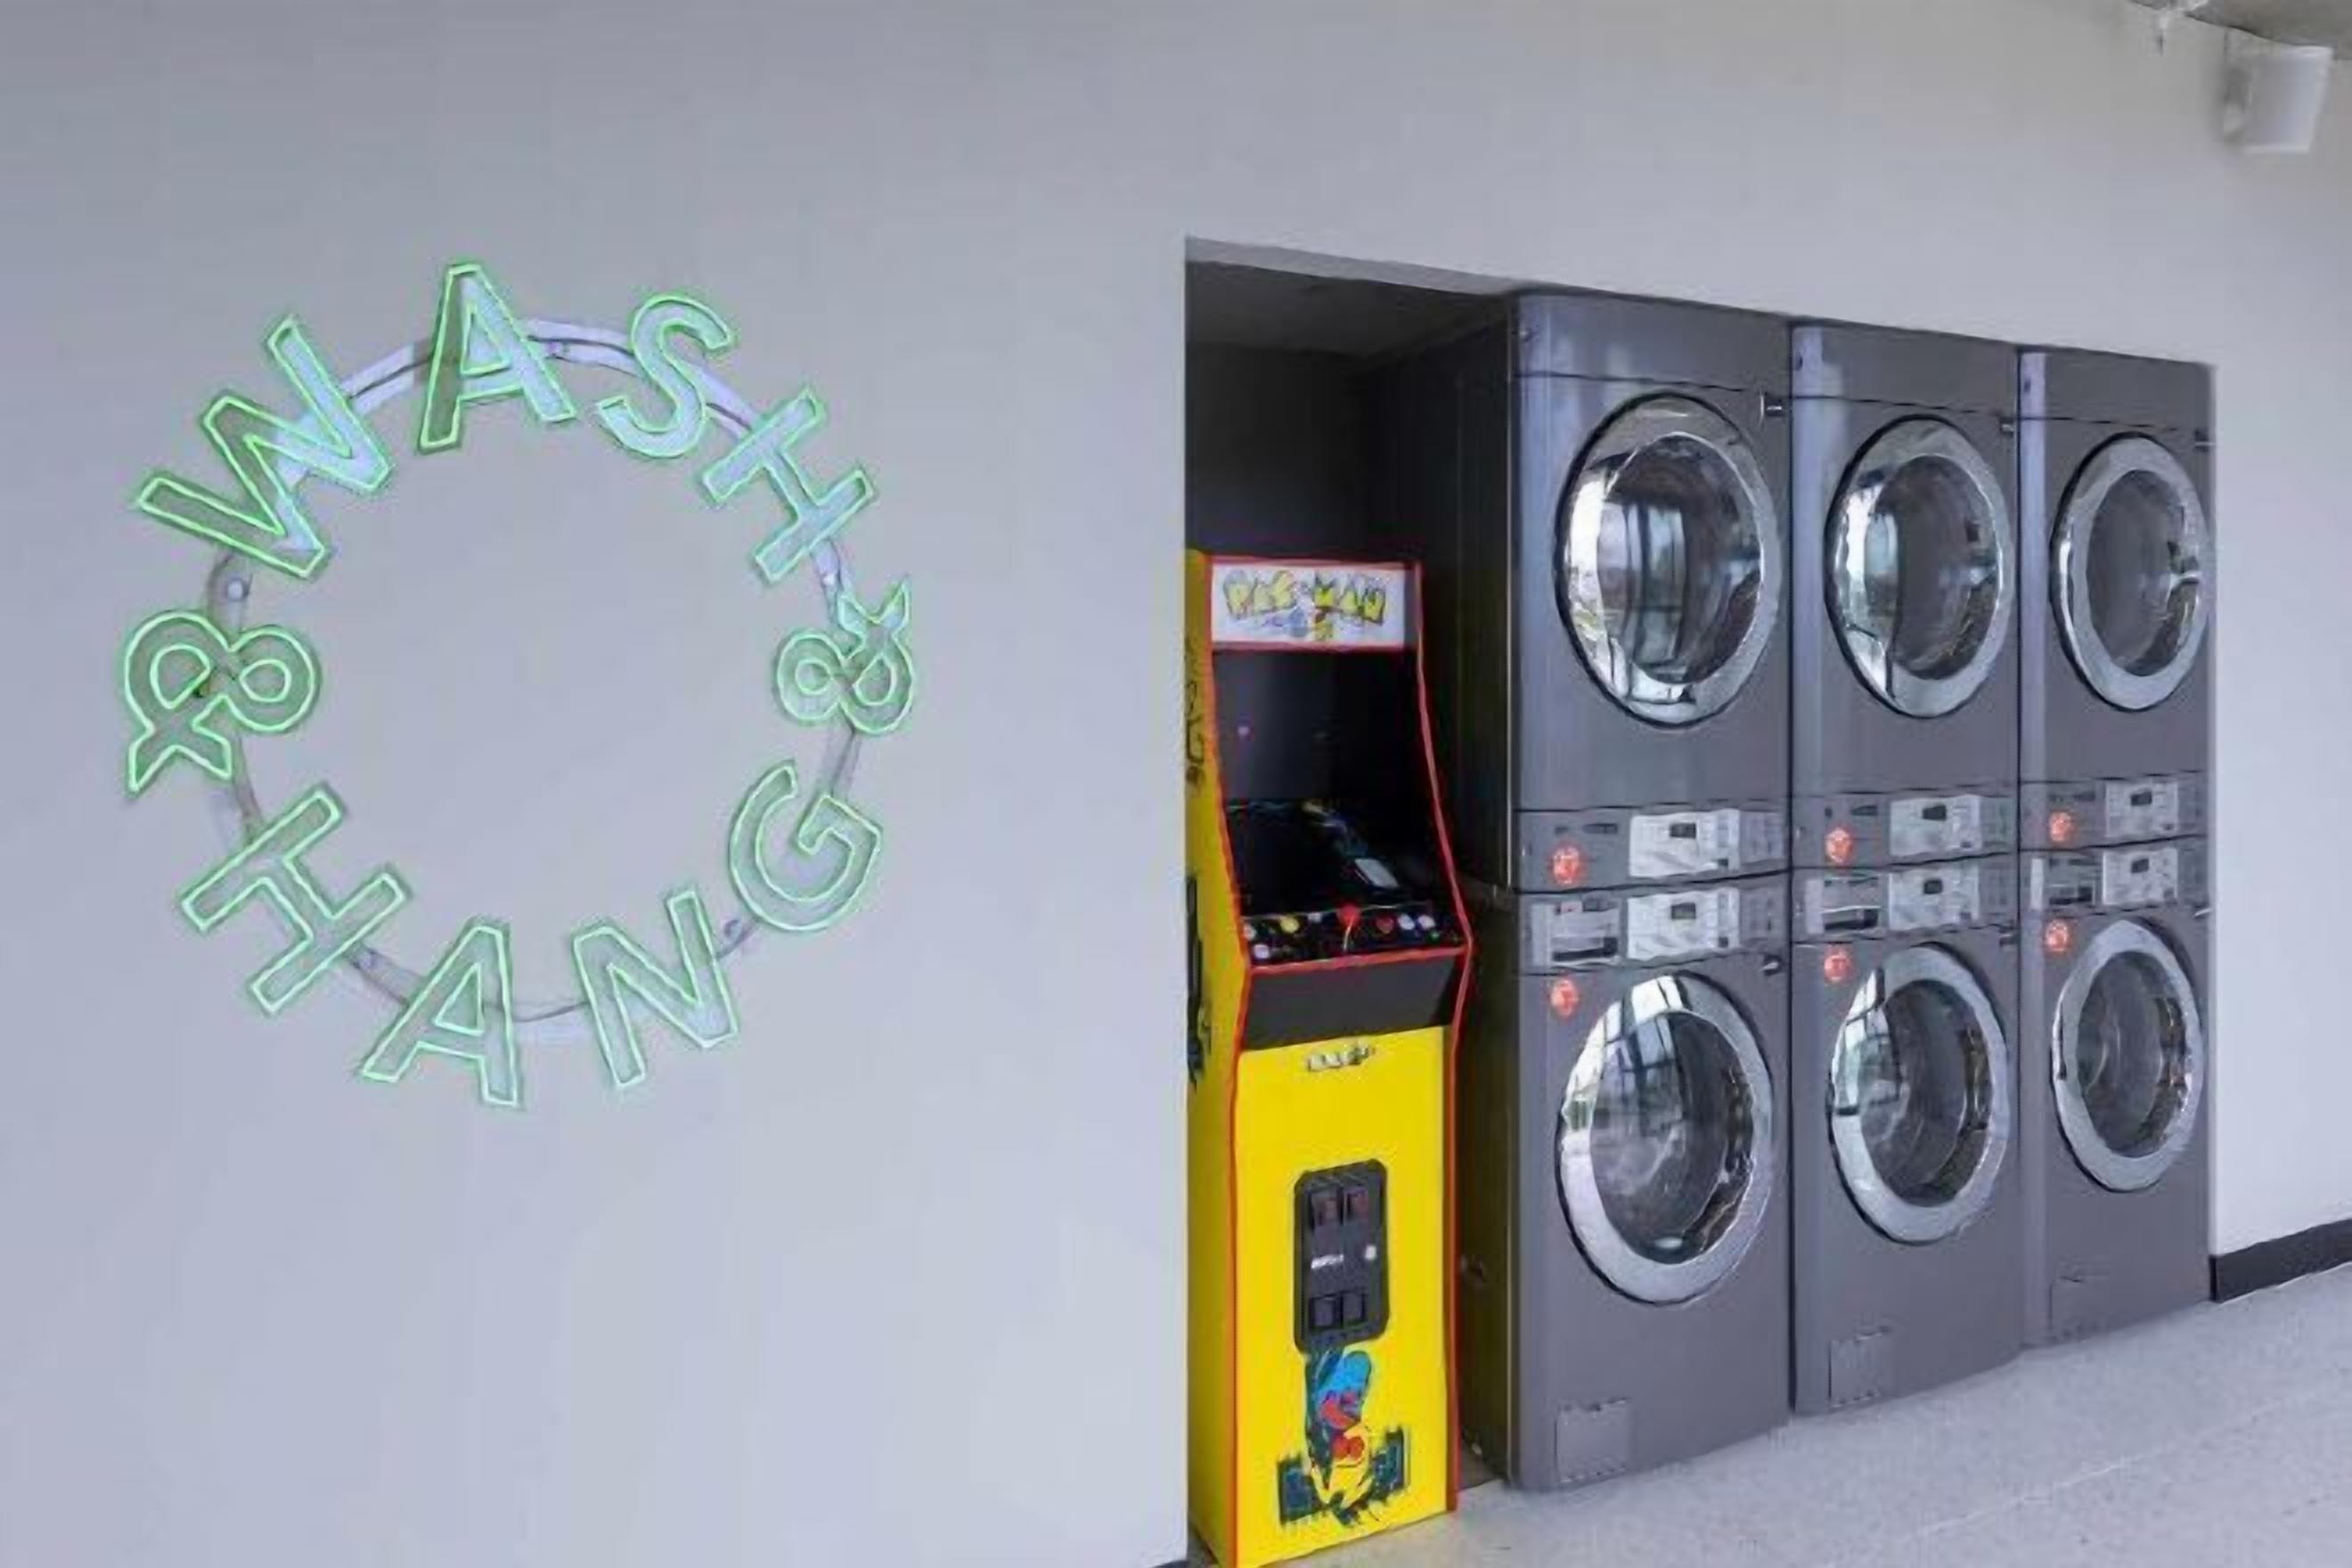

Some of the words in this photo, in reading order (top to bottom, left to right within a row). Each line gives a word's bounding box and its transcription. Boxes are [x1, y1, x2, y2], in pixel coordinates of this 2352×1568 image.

[137, 261, 878, 580] WASH
[775, 582, 914, 735] &
[123, 608, 320, 792] &
[180, 761, 884, 1107] HANG
